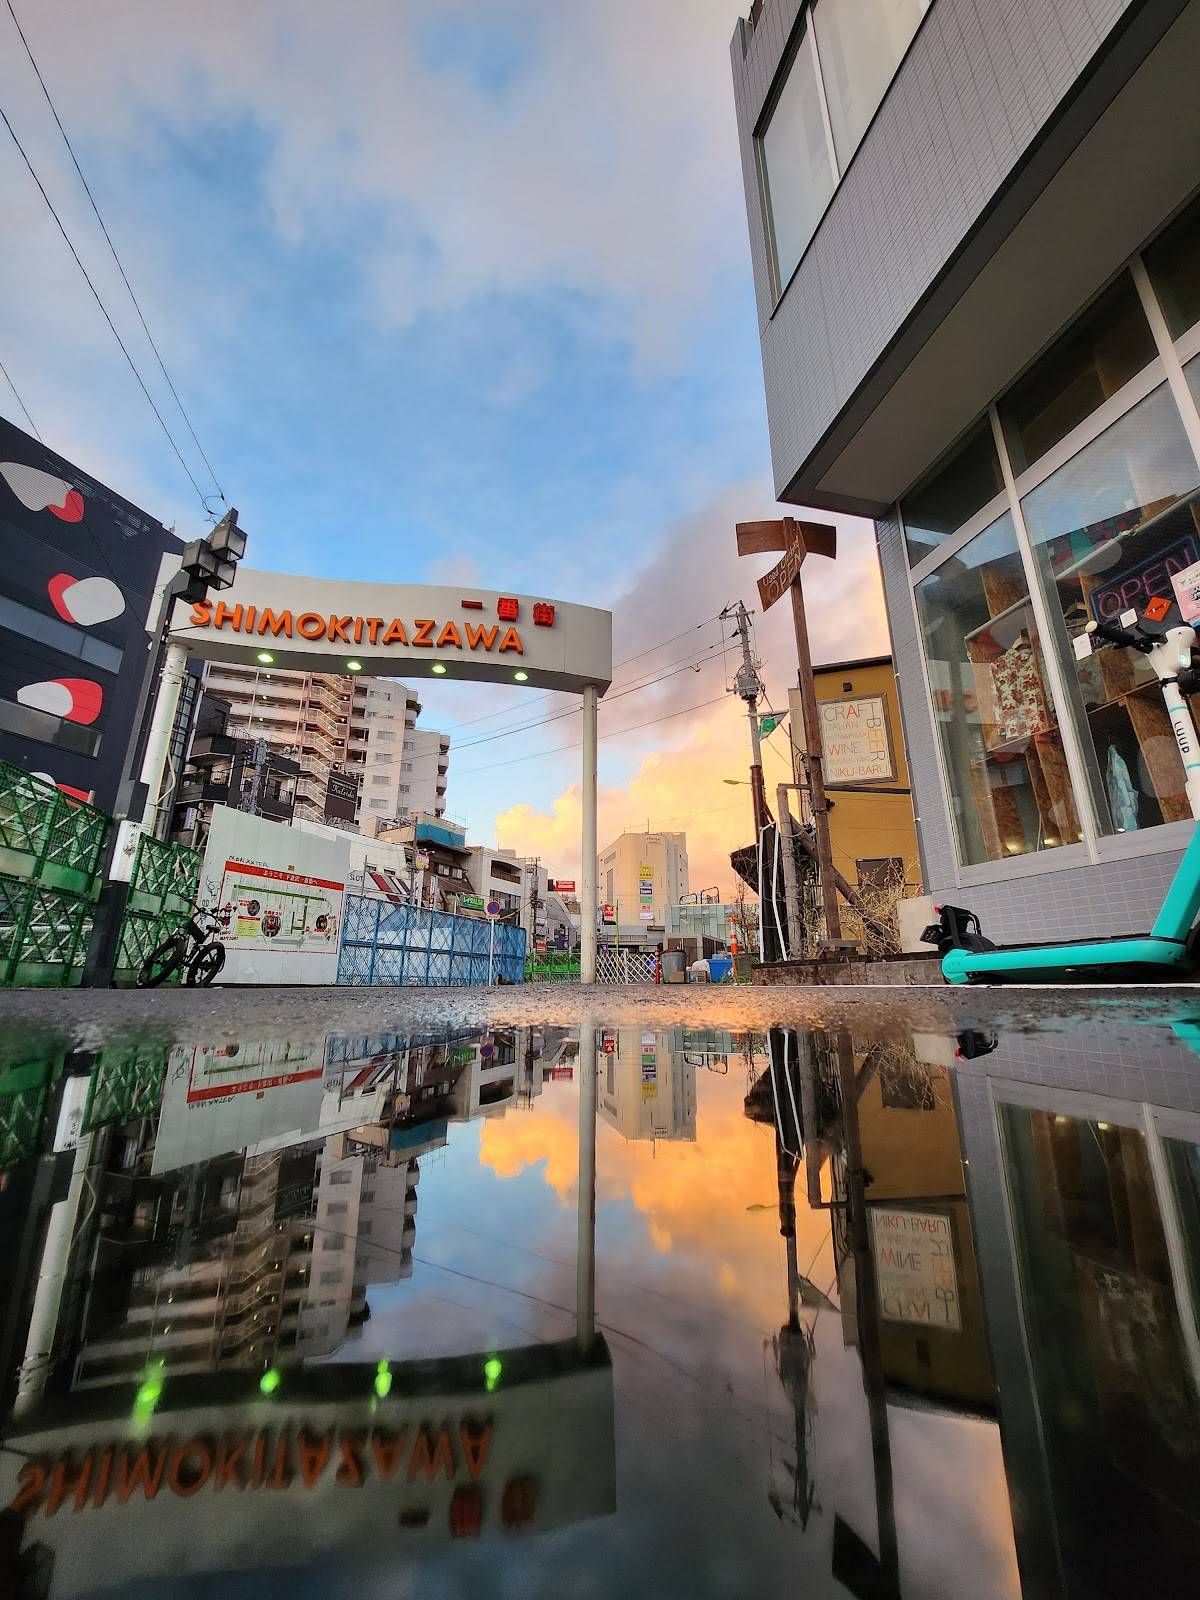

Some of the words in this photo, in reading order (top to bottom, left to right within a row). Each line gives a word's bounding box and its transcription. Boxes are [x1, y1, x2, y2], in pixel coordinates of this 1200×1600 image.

[189, 598, 525, 655] SHIMOKITAZAWA
[461, 597, 555, 627] 一番街
[824, 702, 878, 721] CRAFT
[827, 741, 861, 756] WINE
[867, 718, 886, 762] BEER
